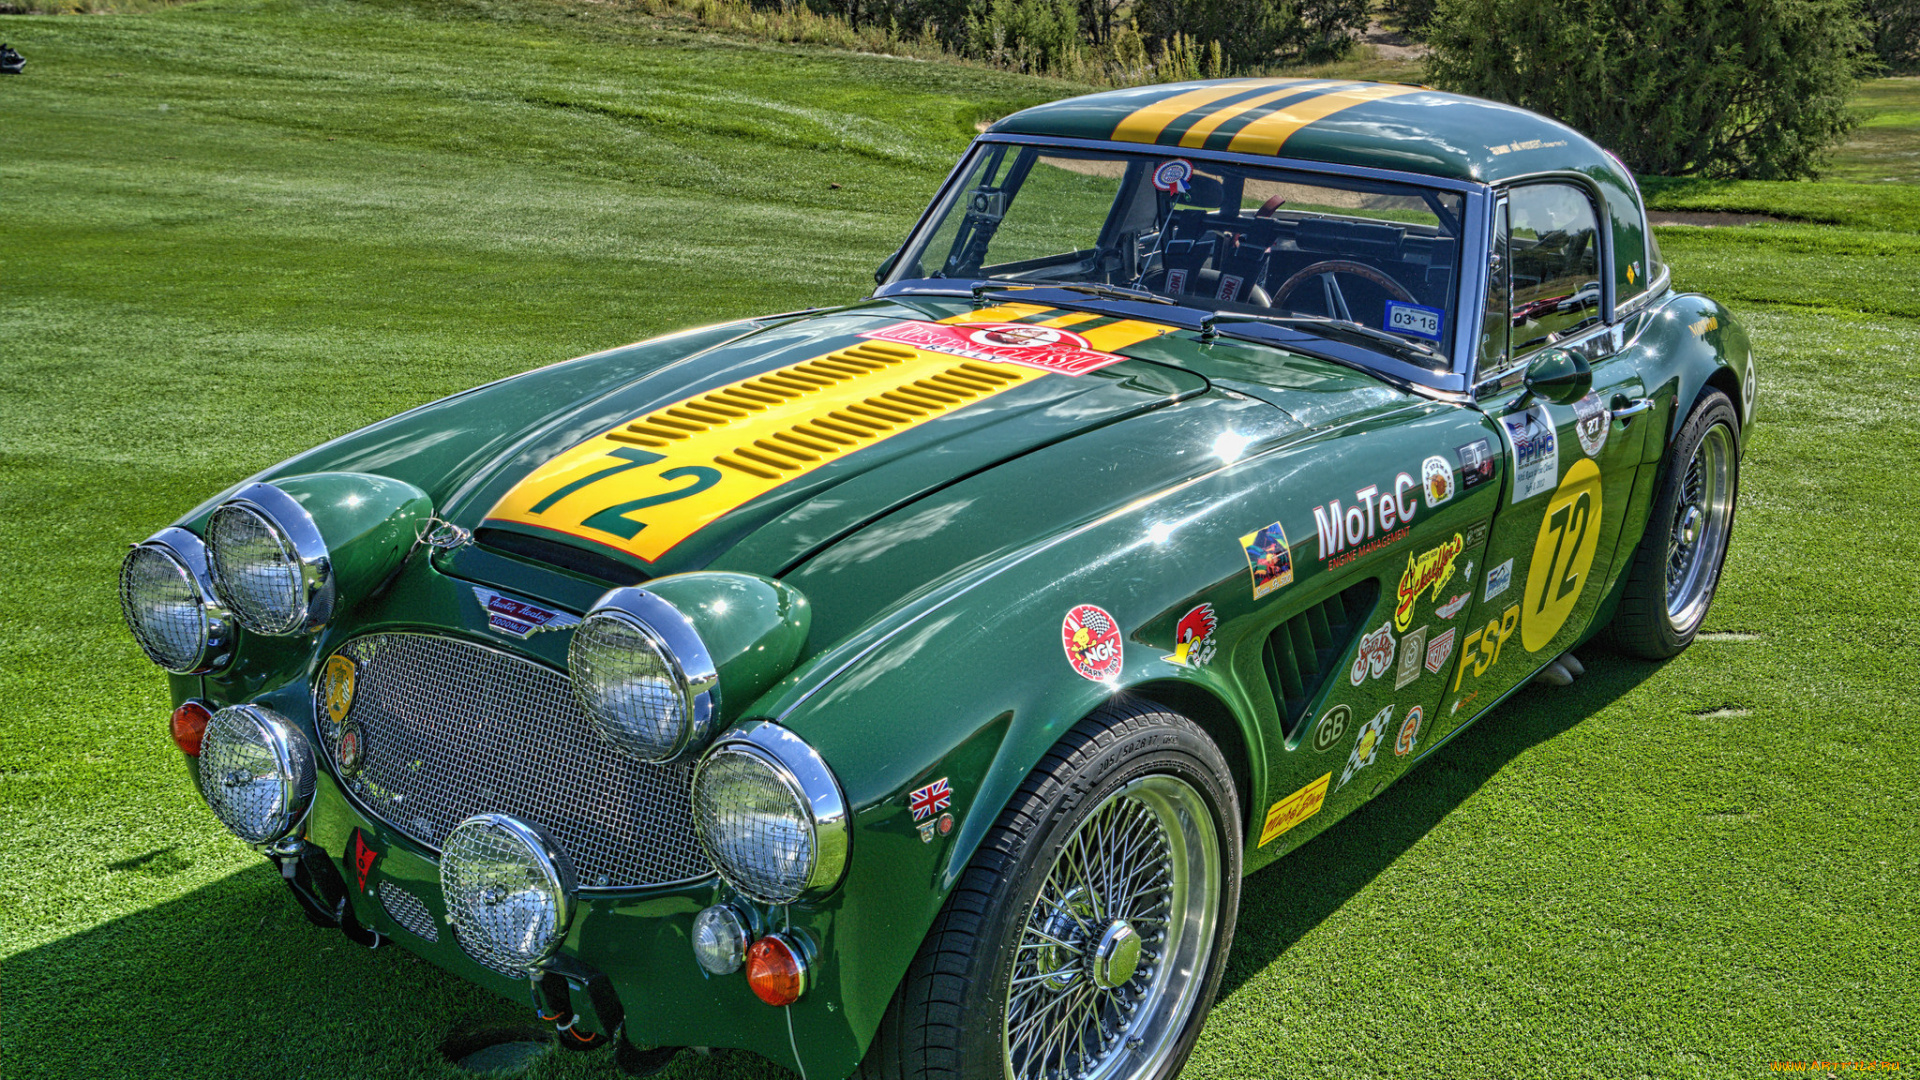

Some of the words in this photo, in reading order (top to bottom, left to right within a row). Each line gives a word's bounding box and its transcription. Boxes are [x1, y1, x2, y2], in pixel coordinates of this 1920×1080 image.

[1394, 313, 1412, 325] 03
[1420, 317, 1437, 331] 18
[880, 323, 997, 353] CRESCENT
[993, 347, 1111, 371] CLASSIC
[925, 344, 1003, 361] RALLY
[1587, 417, 1600, 436] 27
[528, 446, 723, 541] 72
[1313, 472, 1417, 561] MoTeC
[1328, 549, 1357, 572] ENGINE
[1358, 526, 1411, 558] MANAGEMENT
[1536, 491, 1591, 615] 72
[518, 605, 551, 624] Healey
[1084, 637, 1119, 667] NGK
[1453, 604, 1520, 693] FSP
[1079, 661, 1103, 677] SPARK
[1319, 711, 1345, 747] GB
